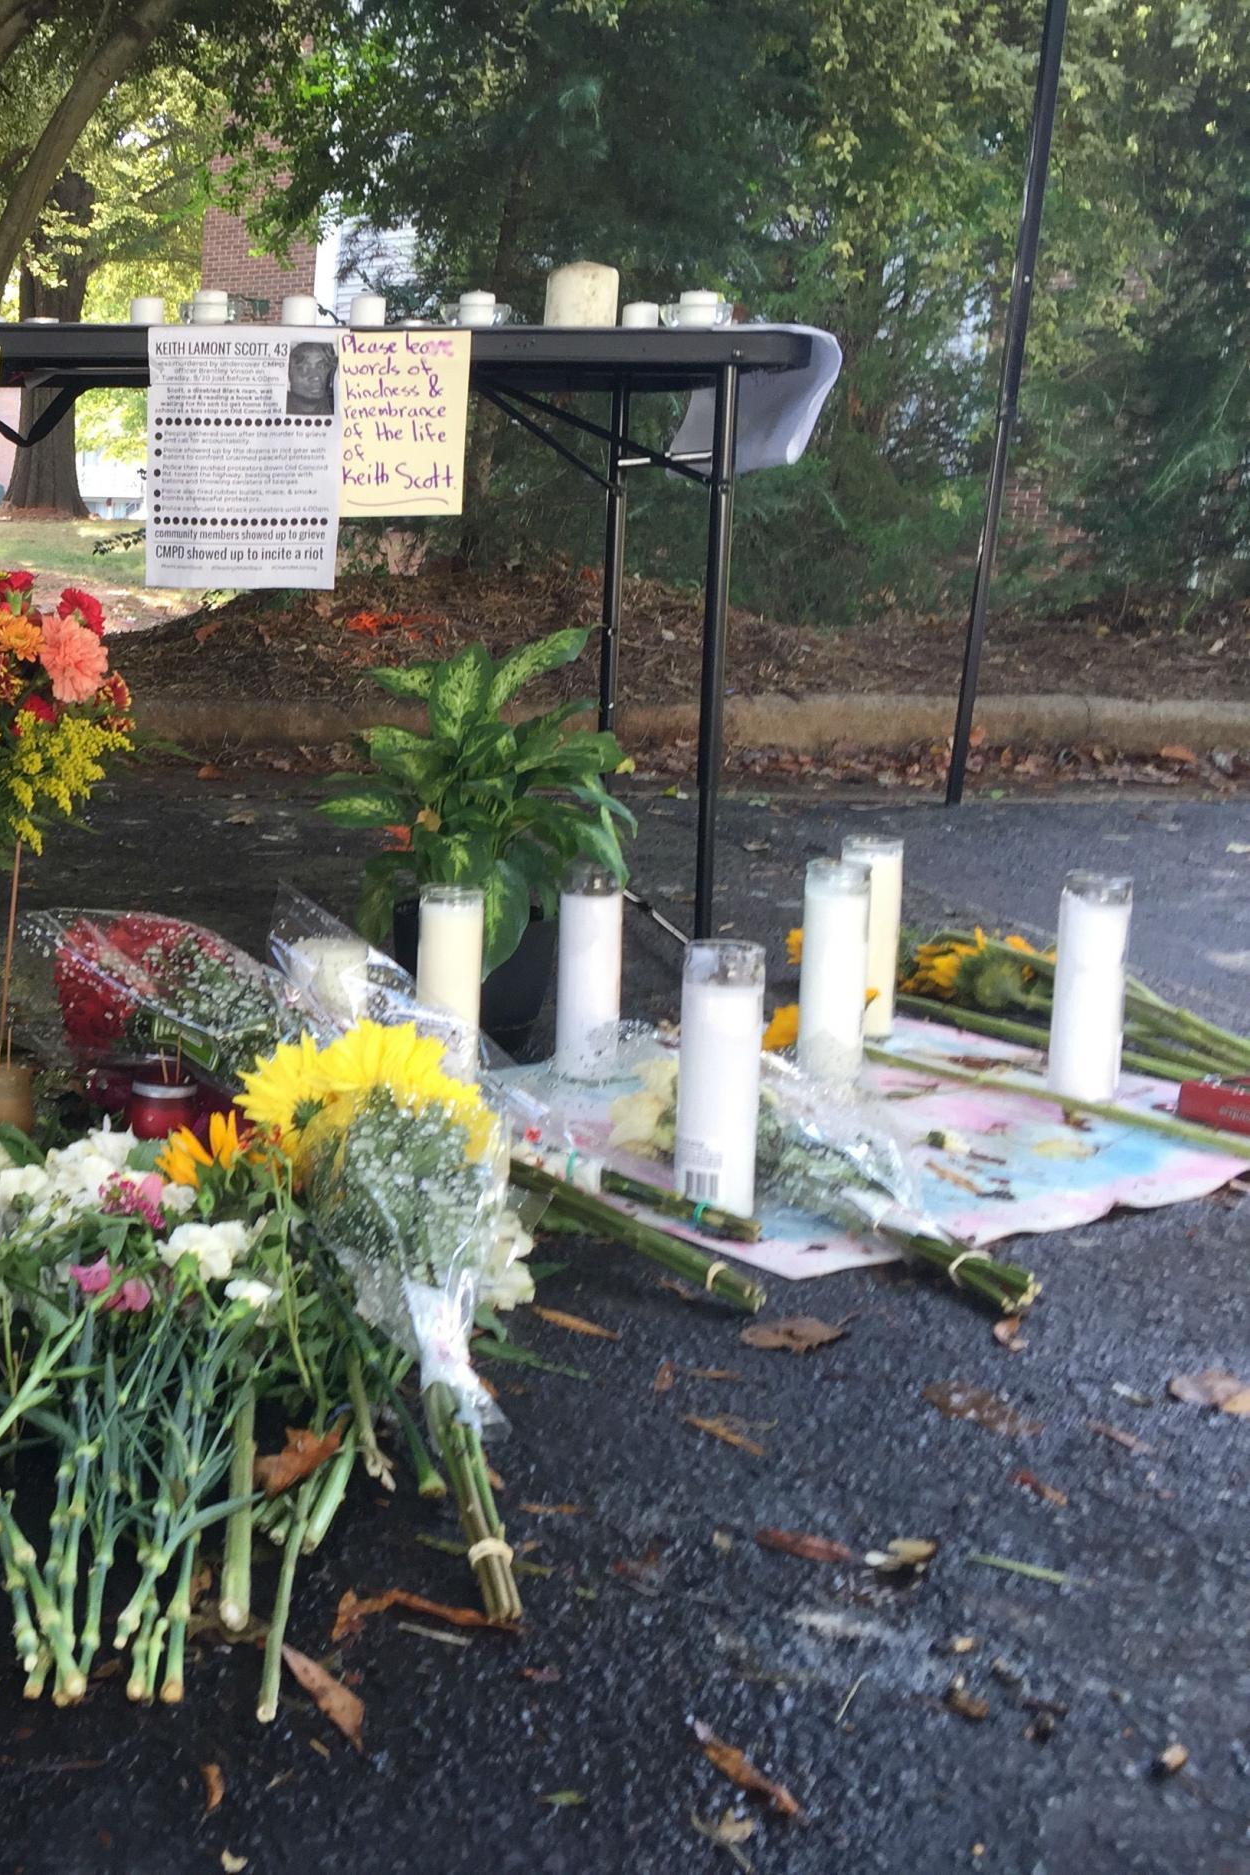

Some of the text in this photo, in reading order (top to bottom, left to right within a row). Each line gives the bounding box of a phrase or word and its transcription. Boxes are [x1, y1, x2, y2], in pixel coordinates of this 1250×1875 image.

[155, 341, 288, 358] KEITH LAMONT SCOTT, 43
[342, 333, 397, 355] Please
[342, 356, 433, 376] words of
[345, 374, 444, 400] kindness &
[343, 419, 448, 443] of the life
[343, 444, 365, 462] of
[341, 461, 390, 487] Keith
[155, 529, 326, 542] community members showed up to grieve
[155, 545, 324, 563] CMPD showed up to incite a riot
